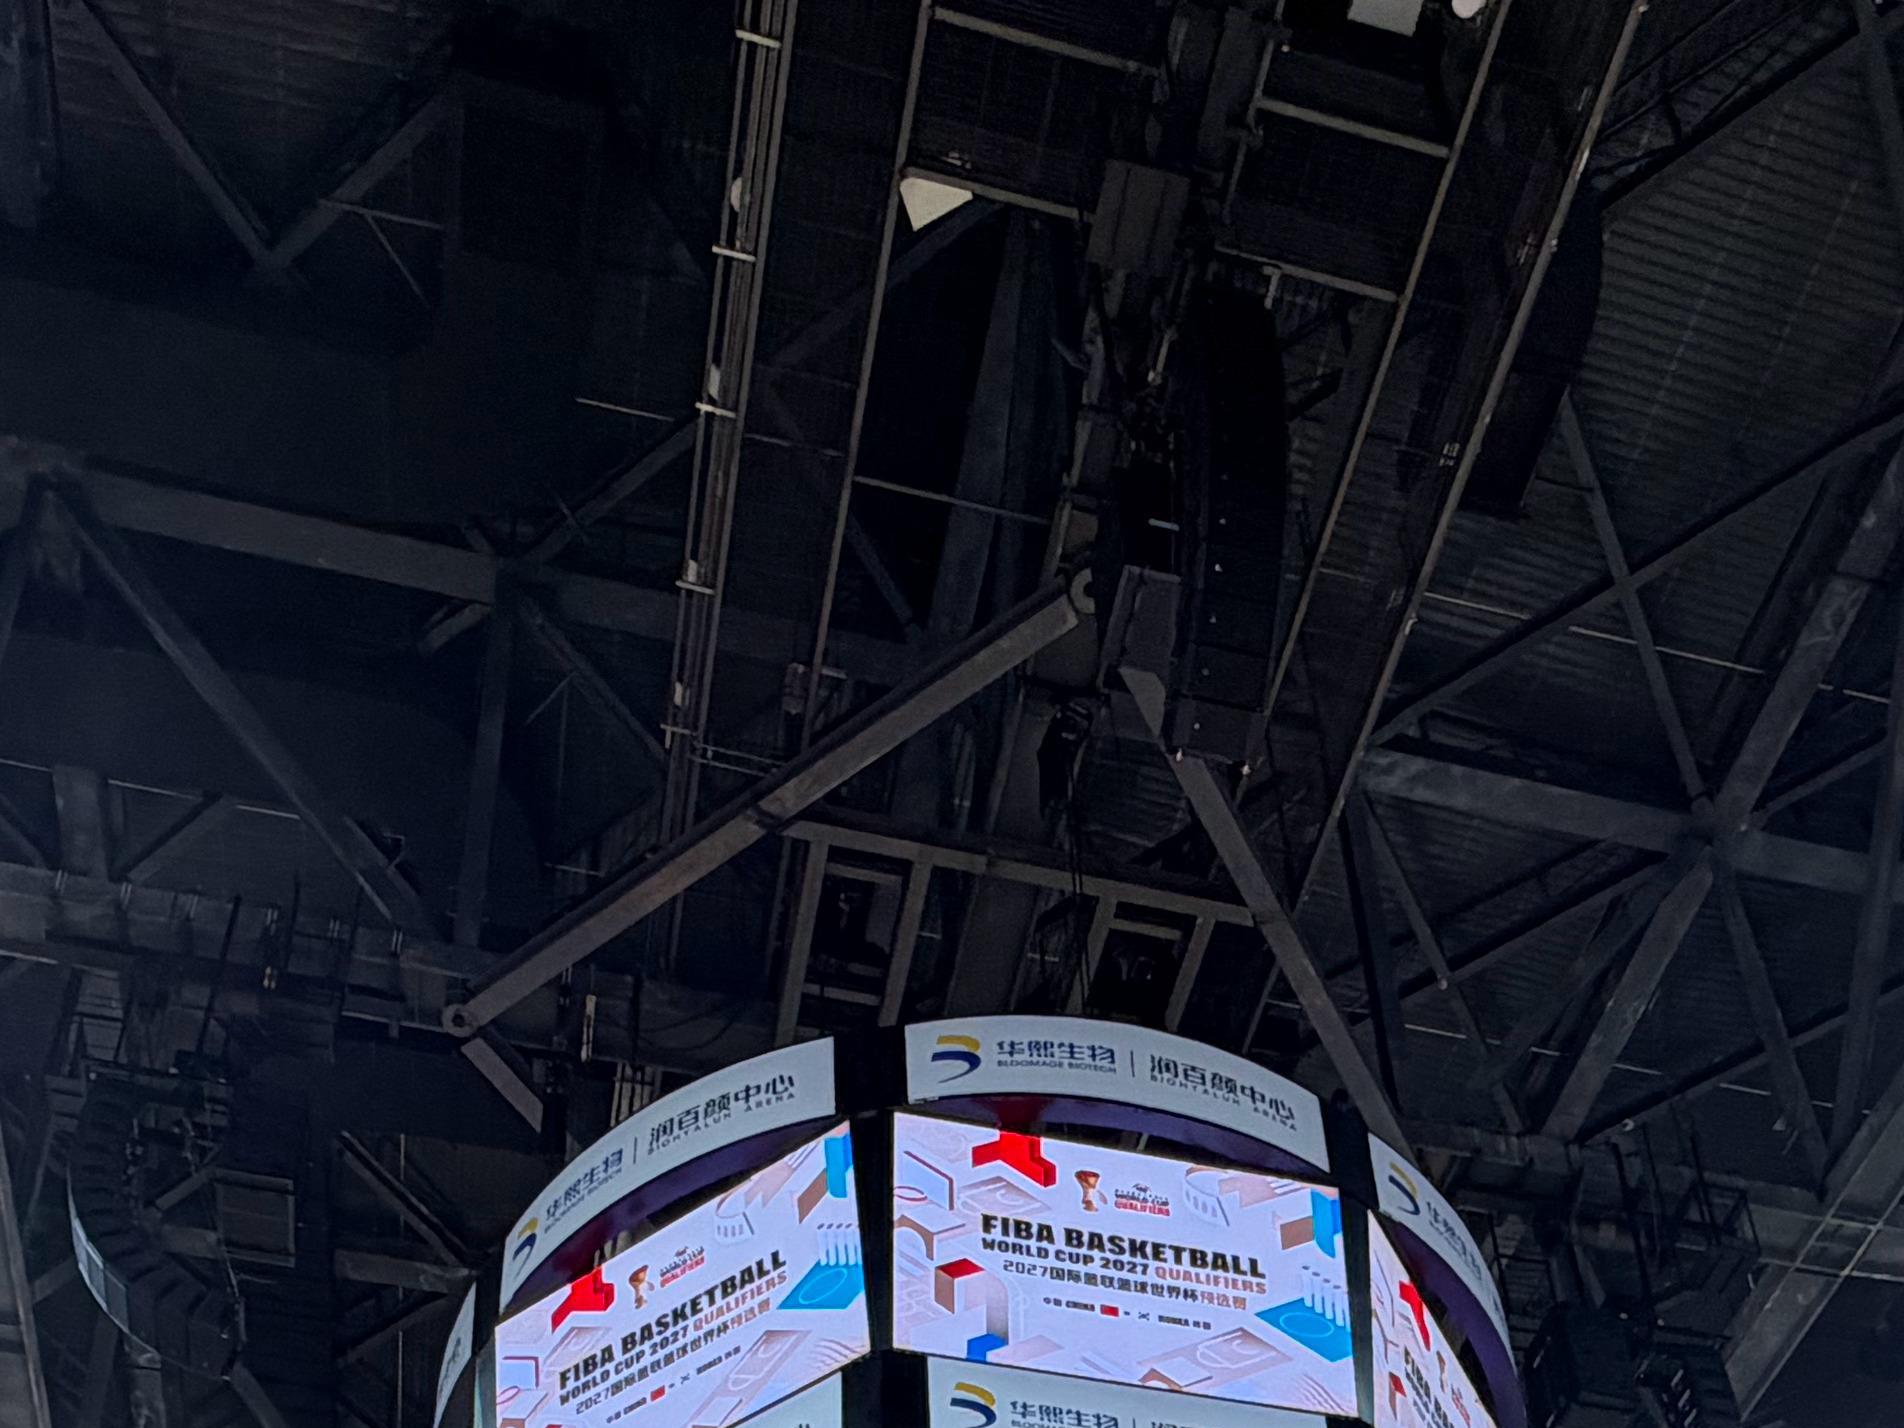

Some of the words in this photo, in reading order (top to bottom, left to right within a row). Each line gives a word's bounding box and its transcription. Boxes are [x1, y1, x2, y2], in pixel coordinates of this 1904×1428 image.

[997, 1039, 1116, 1065] 华熙生物
[1150, 1053, 1295, 1121] 润百颜中心
[545, 1148, 623, 1221] 华熙生物
[649, 1073, 795, 1149] 润百颜中心
[981, 1213, 1056, 1244] FIBA
[1063, 1226, 1267, 1279] BASKETBALL
[981, 1237, 1050, 1261] WORLD
[1054, 1247, 1094, 1267] CUP
[1099, 1256, 1149, 1276] 2027
[1154, 1265, 1267, 1296] QUALIFIERS
[559, 1344, 616, 1390] FIBA
[621, 1250, 787, 1357] BASKETBALL
[559, 1369, 611, 1406] WORLD
[614, 1349, 646, 1377] CUP
[649, 1324, 690, 1357] 2027
[692, 1270, 788, 1333] QUALIFIERS
